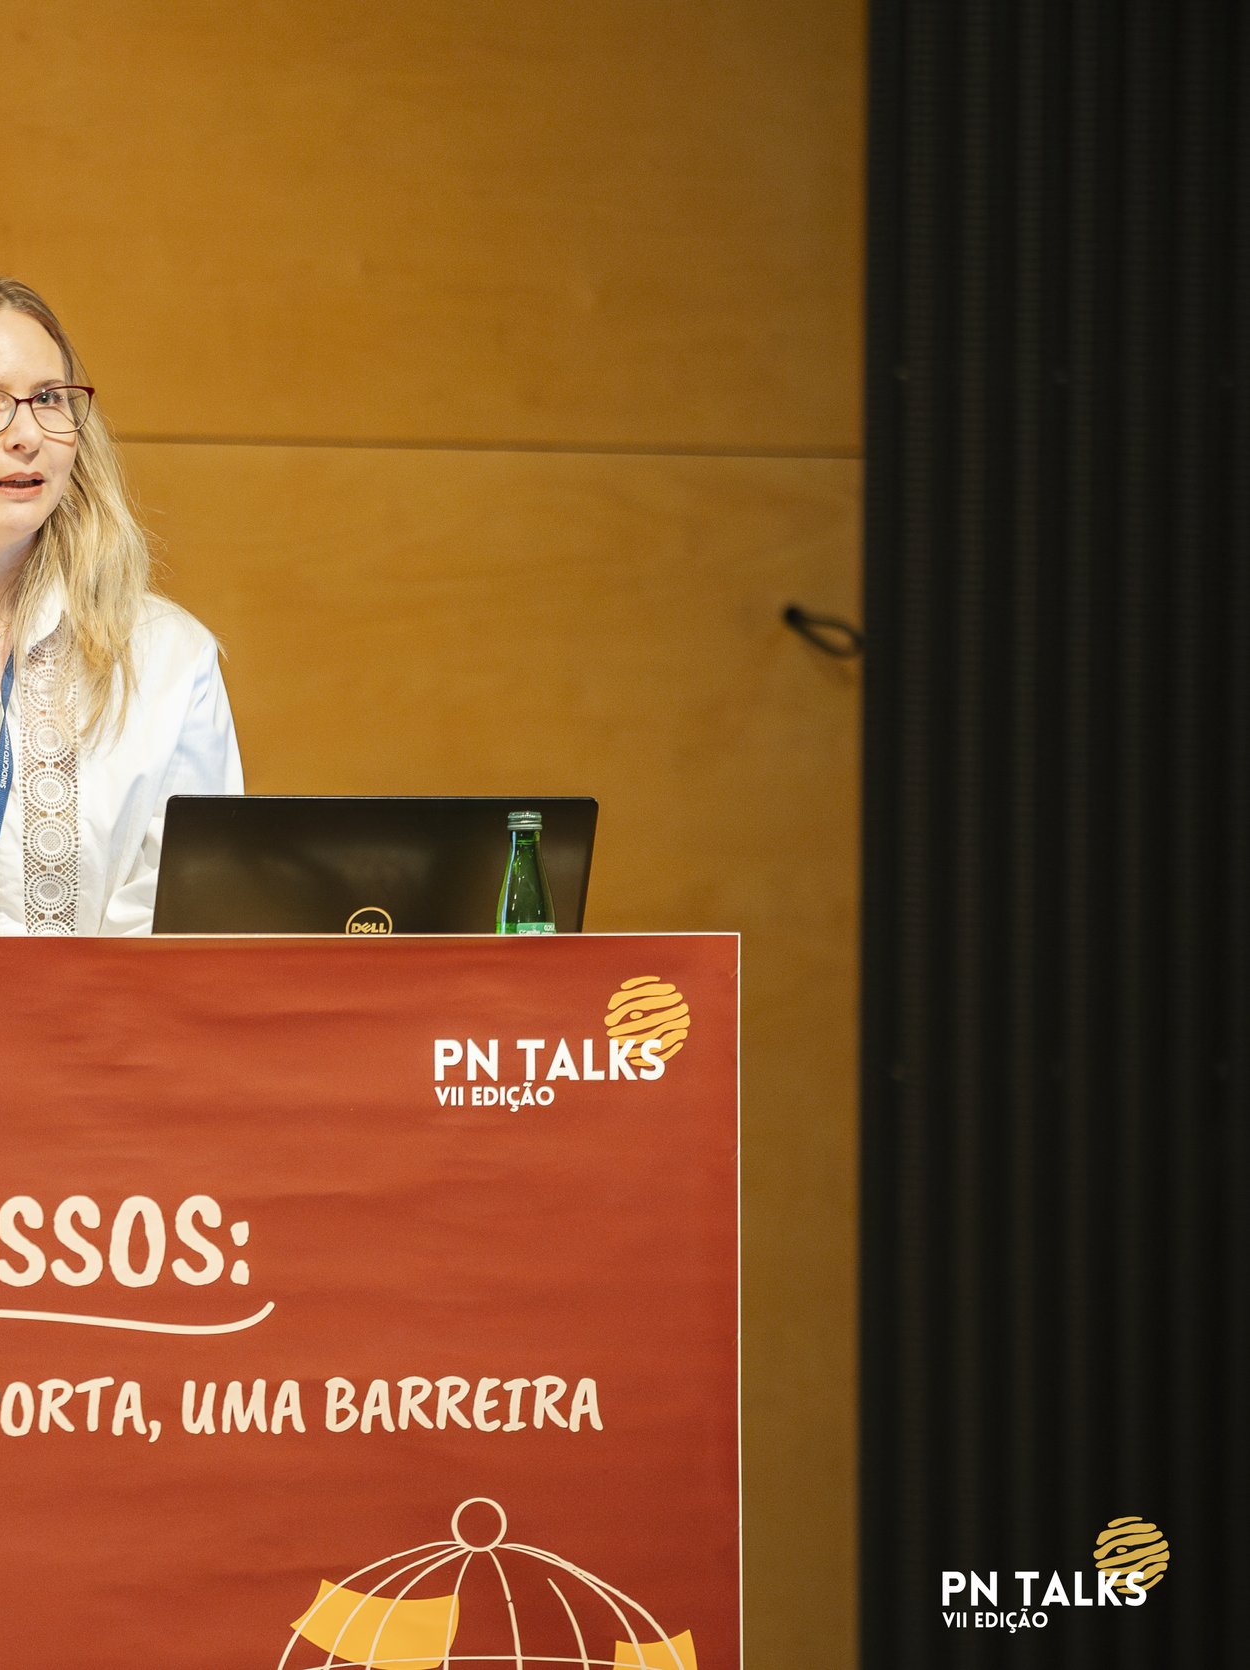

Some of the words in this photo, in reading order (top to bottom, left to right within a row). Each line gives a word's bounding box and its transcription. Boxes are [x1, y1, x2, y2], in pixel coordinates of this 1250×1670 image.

[0, 750, 10, 789] SINDICATO
[351, 922, 387, 934] DELL
[434, 1038, 499, 1082] PN
[516, 1037, 666, 1082] TALKS
[434, 1086, 464, 1107] VII
[471, 1081, 555, 1113] EDIÇÃO
[181, 1378, 306, 1435] UMA
[324, 1375, 604, 1434] BARREIRA
